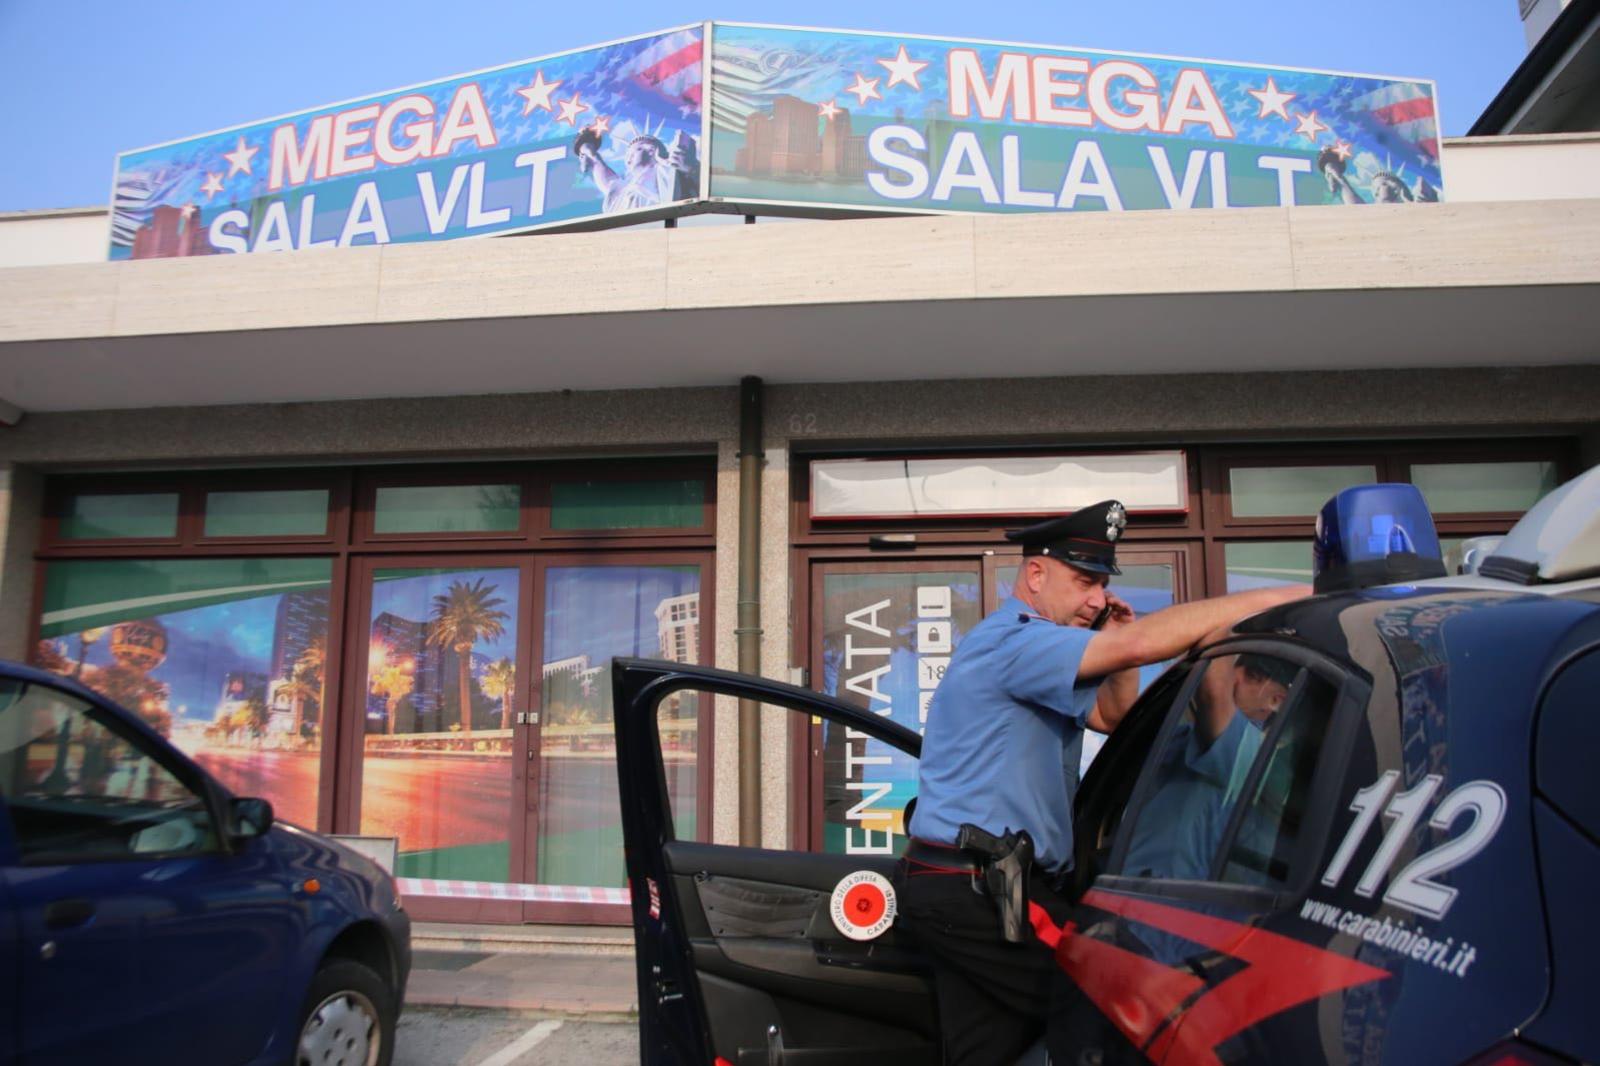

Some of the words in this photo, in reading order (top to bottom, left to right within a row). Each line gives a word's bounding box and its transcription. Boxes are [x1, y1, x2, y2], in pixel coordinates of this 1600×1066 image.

[268, 82, 498, 192] MEGA
[946, 47, 1235, 139] MEGA
[207, 181, 391, 256] SALA
[415, 145, 567, 236] VLT
[865, 124, 1124, 211] SALA
[1321, 769, 1508, 921] 112
[1300, 898, 1477, 978] www.carabinieri.it
